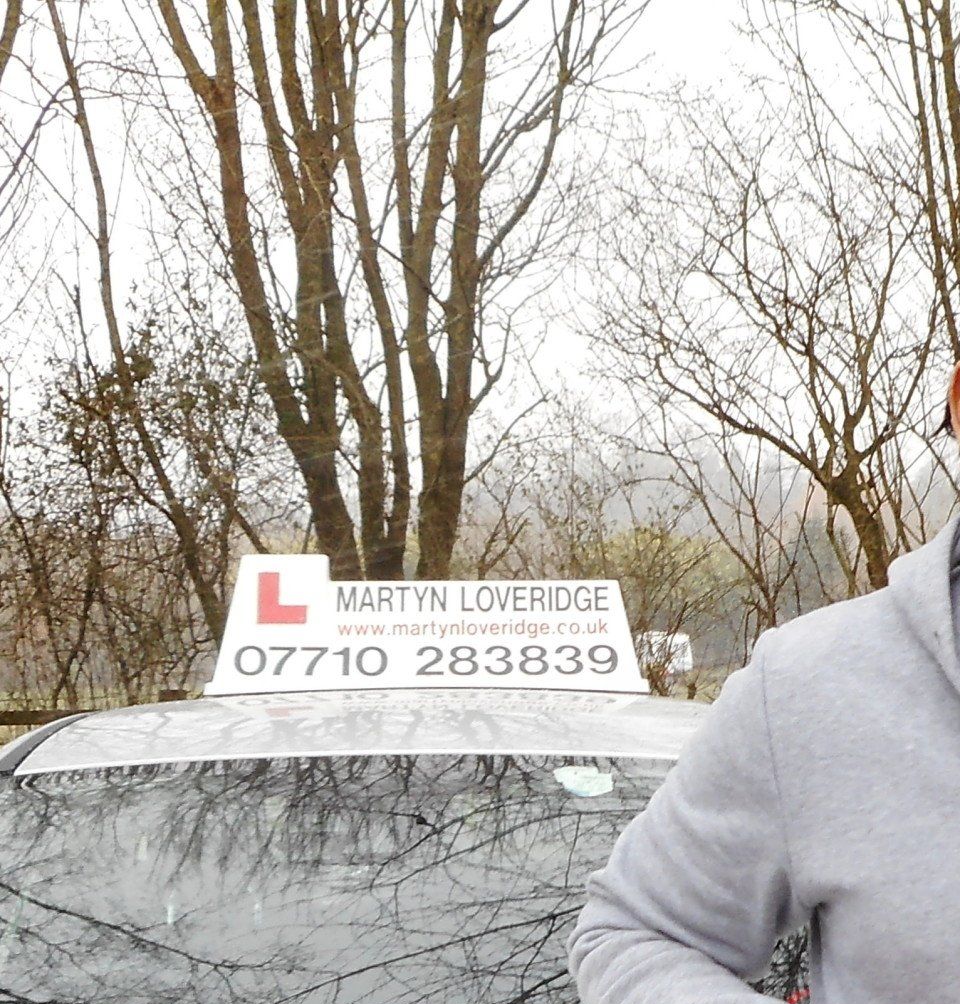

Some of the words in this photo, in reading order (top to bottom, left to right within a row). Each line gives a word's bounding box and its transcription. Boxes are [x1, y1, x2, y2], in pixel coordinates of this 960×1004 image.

[257, 572, 308, 624] L
[336, 586, 447, 612] MARTYN
[461, 585, 609, 611] LOVERIDGE
[338, 618, 608, 638] www.martynloveridge.co.uk
[234, 645, 388, 676] 07710
[415, 645, 619, 675] 283839
